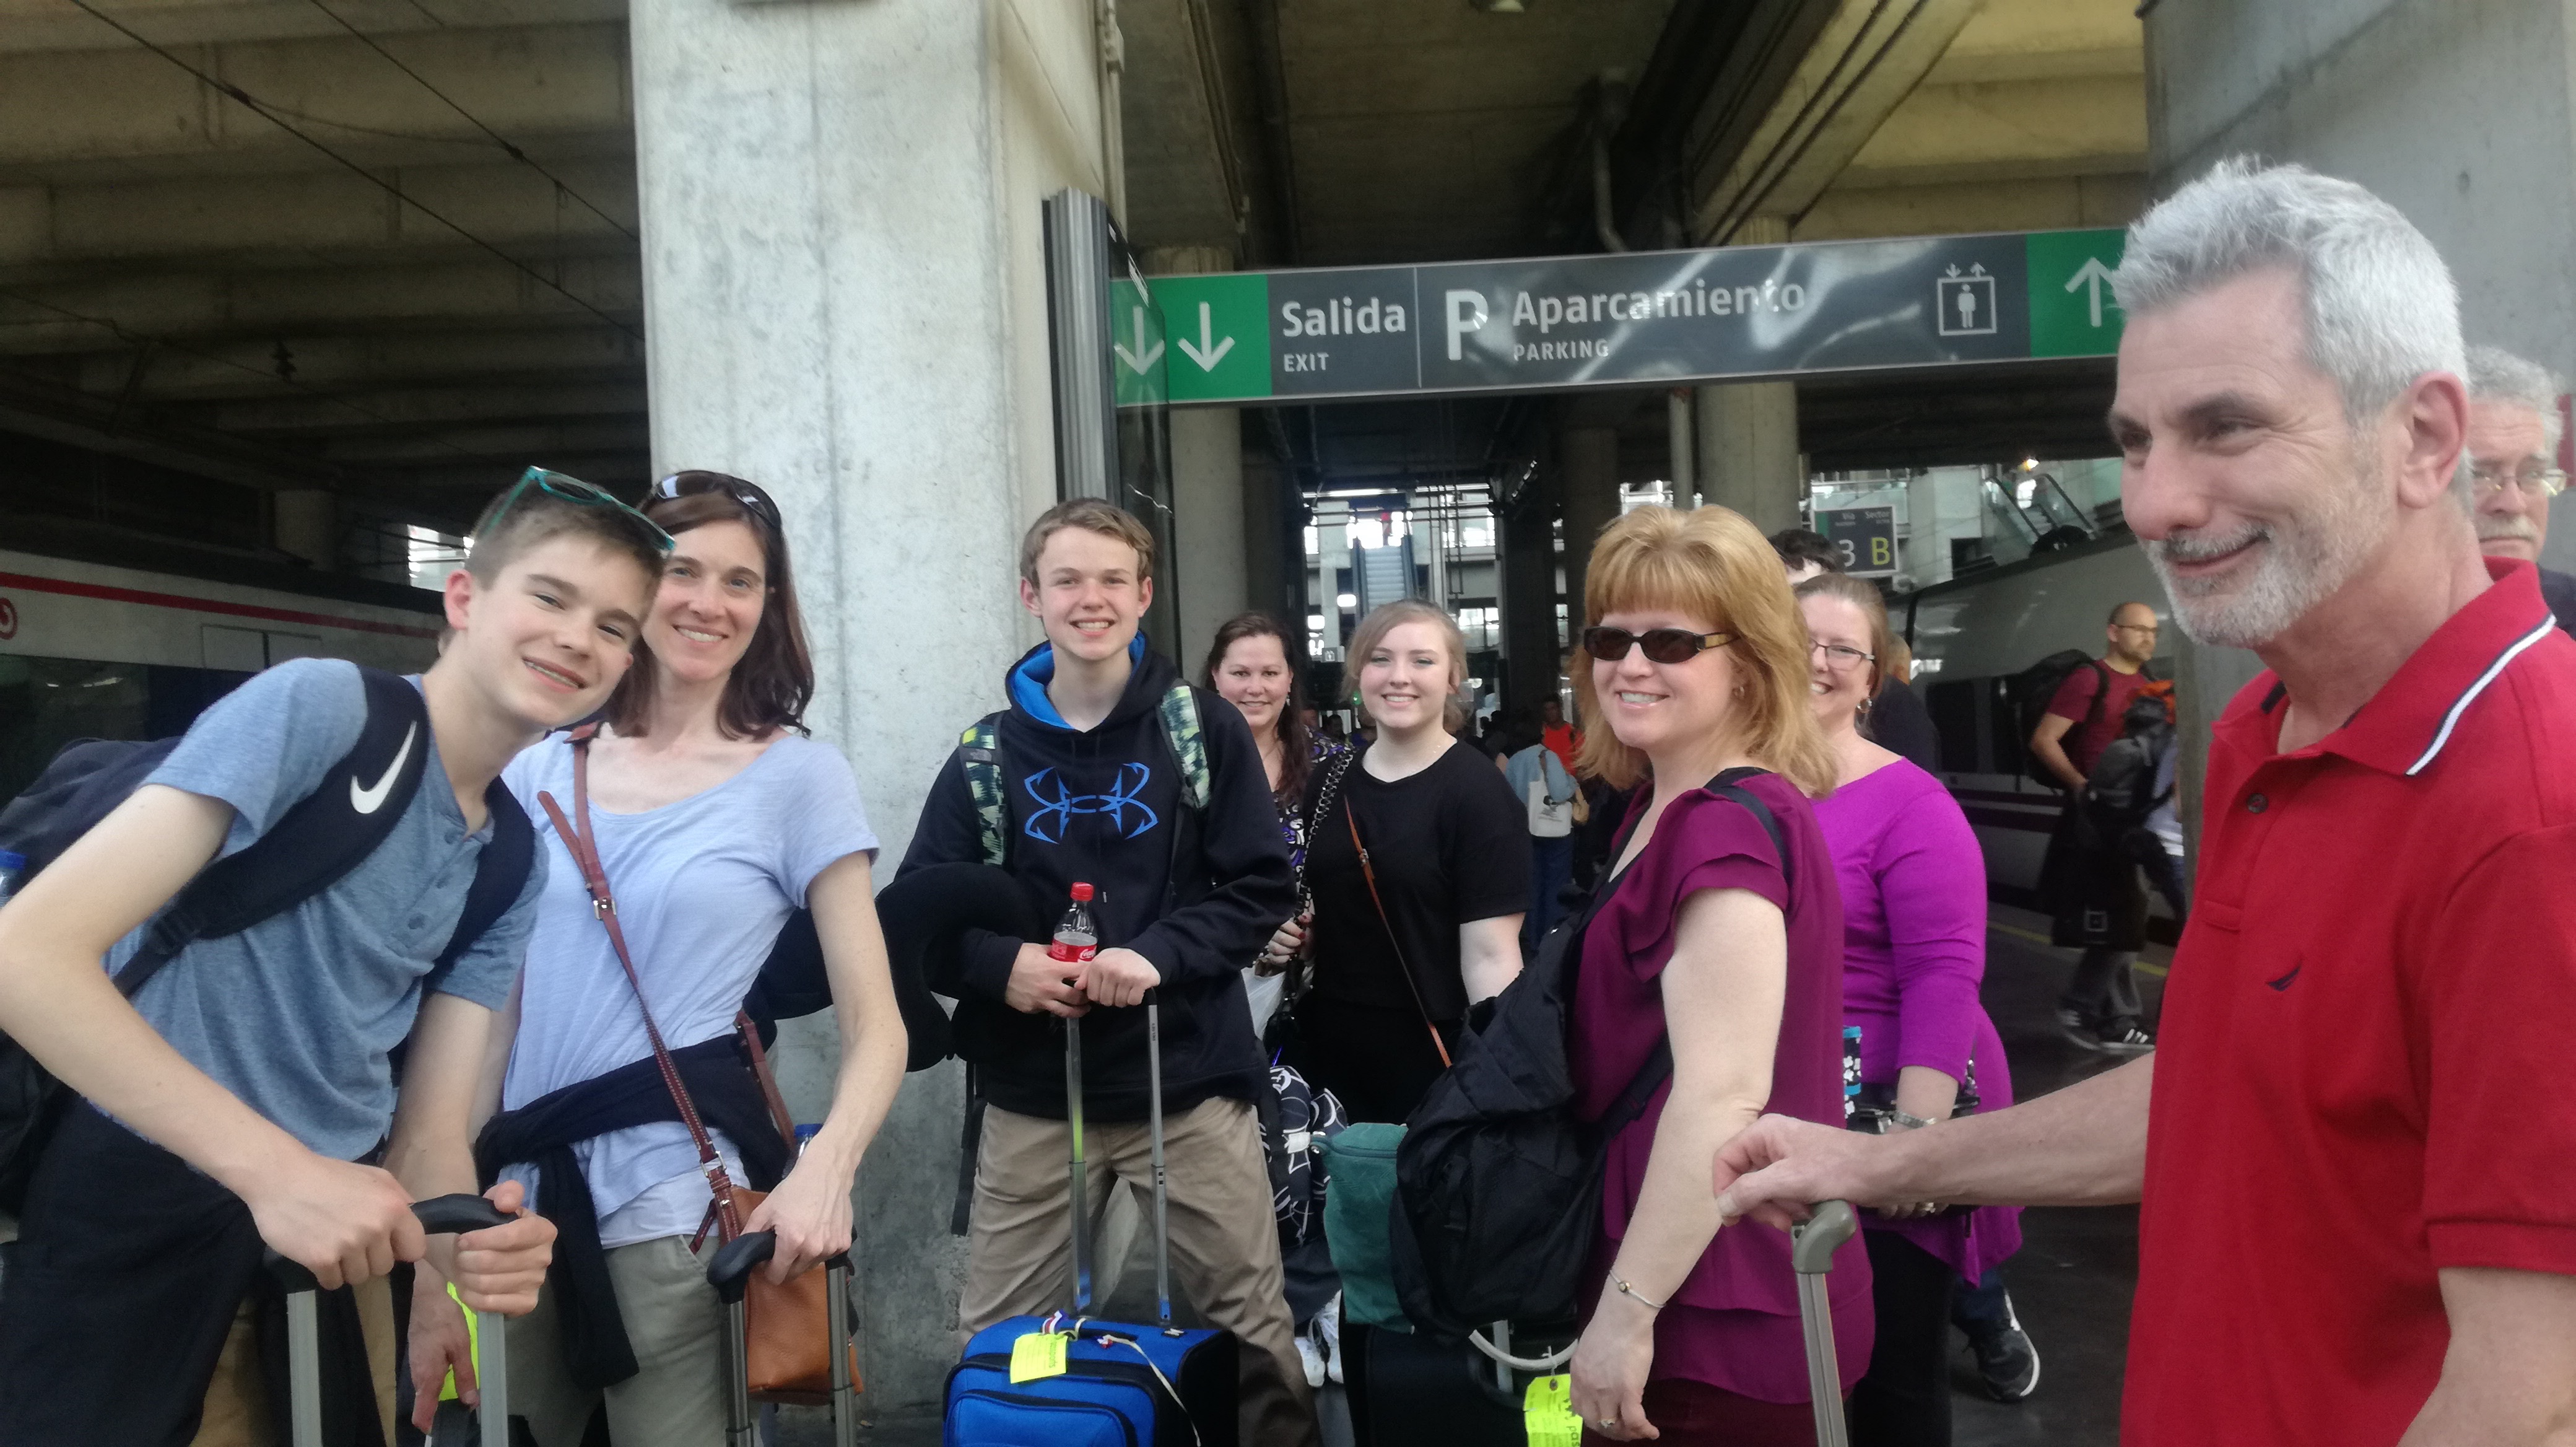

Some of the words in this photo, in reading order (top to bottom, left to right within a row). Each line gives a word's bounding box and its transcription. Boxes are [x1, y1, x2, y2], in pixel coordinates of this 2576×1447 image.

[1282, 296, 1406, 336] Salida
[1513, 278, 1804, 333] Aparcamiento
[1446, 289, 1489, 361] P
[1284, 352, 1329, 372] EXIT
[1513, 338, 1609, 361] PARKING
[1838, 539, 1855, 567] 3
[1871, 537, 1891, 565] B
